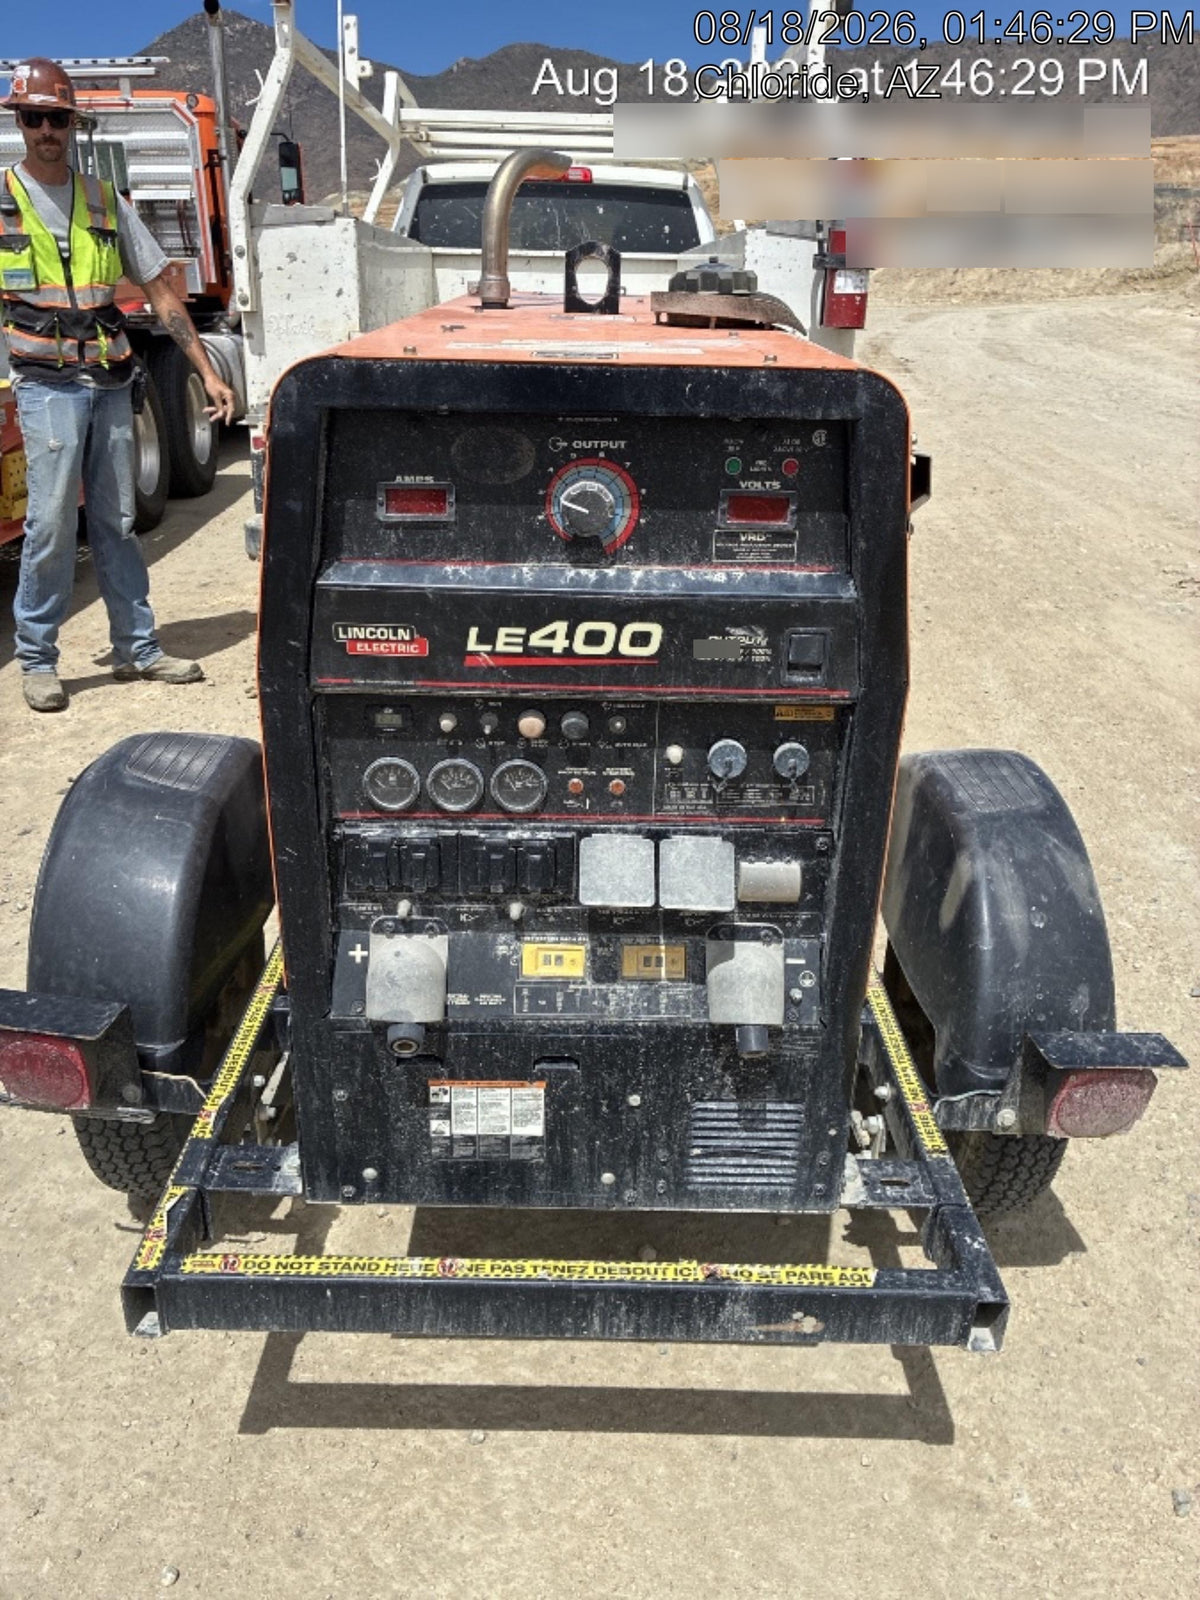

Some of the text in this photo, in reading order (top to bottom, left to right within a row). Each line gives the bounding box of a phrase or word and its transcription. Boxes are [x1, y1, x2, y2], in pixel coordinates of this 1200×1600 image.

[572, 440, 627, 449] OUTPUT
[739, 480, 781, 490] VOLTS
[338, 626, 411, 641] LINCOLN
[467, 620, 663, 657] LE400
[356, 641, 420, 654] ELECTRIC
[244, 1260, 271, 1270] DO
[275, 1261, 315, 1270] NOT
[318, 1261, 380, 1272] STAND
[490, 1264, 527, 1274] PAS
[594, 1266, 669, 1276] DEBOUT
[786, 1270, 835, 1281] PARE
